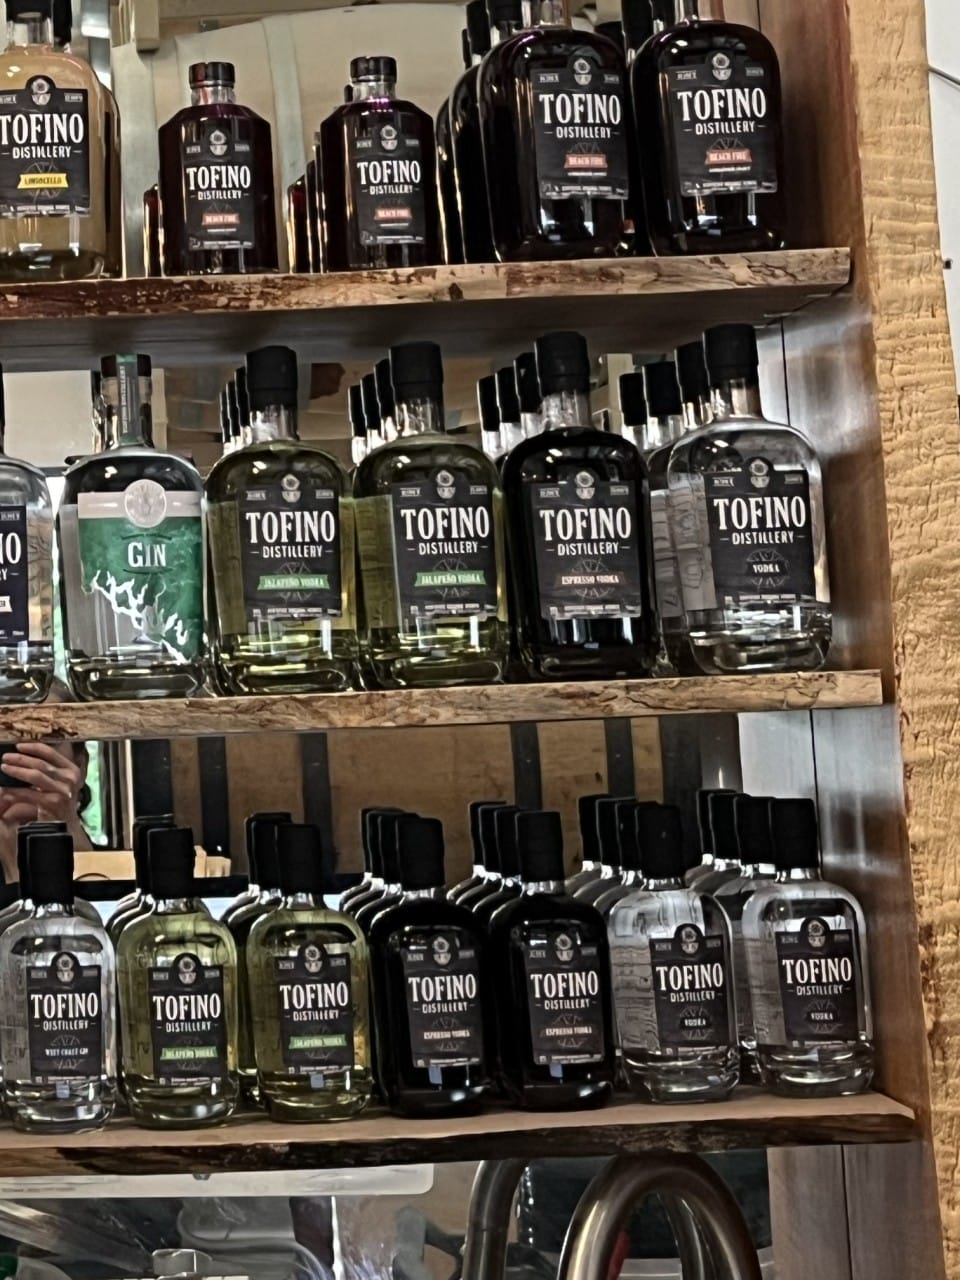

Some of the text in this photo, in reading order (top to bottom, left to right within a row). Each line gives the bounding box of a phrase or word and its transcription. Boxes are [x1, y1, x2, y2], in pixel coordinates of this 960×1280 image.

[540, 94, 621, 124] TOFINO
[677, 88, 766, 121] TOFINO
[556, 127, 611, 138] DISTILLERY
[696, 121, 755, 135] DISTILLERY
[13, 146, 71, 159] DISTILLERY
[186, 165, 251, 190] TOFINO
[357, 160, 420, 185] TOFINO
[198, 190, 241, 200] DISTILLERY
[370, 185, 413, 195] DISTILLERY
[713, 496, 806, 530] TOFINO
[246, 511, 335, 543] TOFINO
[400, 506, 489, 540] TOFINO
[540, 507, 631, 541] TOFINO
[732, 531, 793, 545] DISTILLERY
[128, 543, 167, 567] GIN
[263, 546, 322, 558] DISTILLERY
[419, 542, 478, 555] DISTILLERY
[558, 542, 619, 556] DISTILLERY
[753, 564, 780, 573] VODKA
[656, 963, 723, 991] TOFINO
[782, 958, 852, 984] TOFINO
[408, 974, 476, 1002] TOFINO
[530, 971, 598, 998] TOFINO
[796, 984, 842, 996] DISTILLERY
[280, 982, 348, 1009] TOFINO
[670, 991, 715, 1003] DISTILLERY
[31, 992, 98, 1019] TOFINO
[153, 993, 221, 1020] TOFINO
[422, 1002, 467, 1014] DISTILLERY
[544, 999, 590, 1010] DISTILLERY
[293, 1010, 339, 1021] DISTILLERY
[43, 1020, 88, 1031] DISTILLERY
[166, 1021, 211, 1033] DISTILLERY
